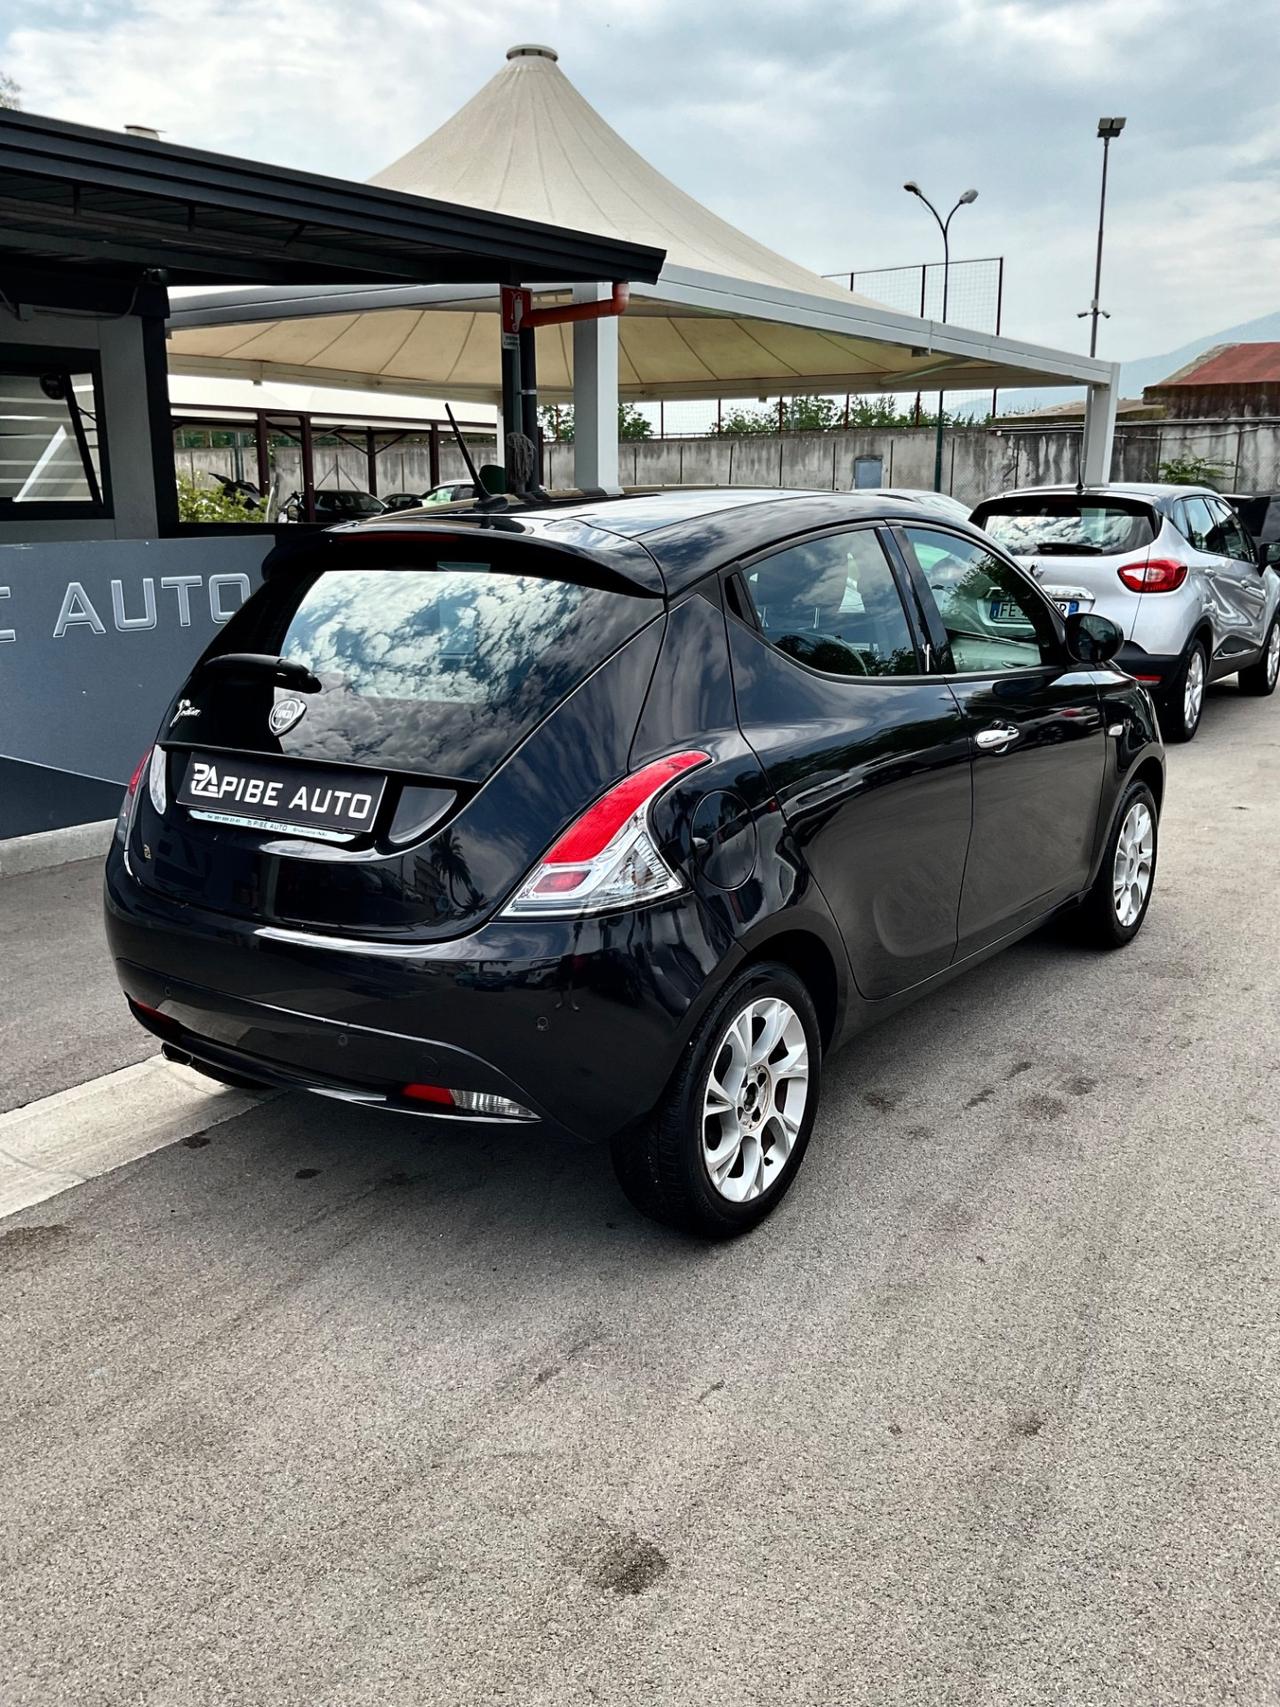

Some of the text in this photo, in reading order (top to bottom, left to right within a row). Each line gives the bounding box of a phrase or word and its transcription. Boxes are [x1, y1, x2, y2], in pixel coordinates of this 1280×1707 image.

[53, 573, 251, 638] AUTO
[219, 776, 284, 806] PIBE
[289, 786, 372, 819] AUTO
